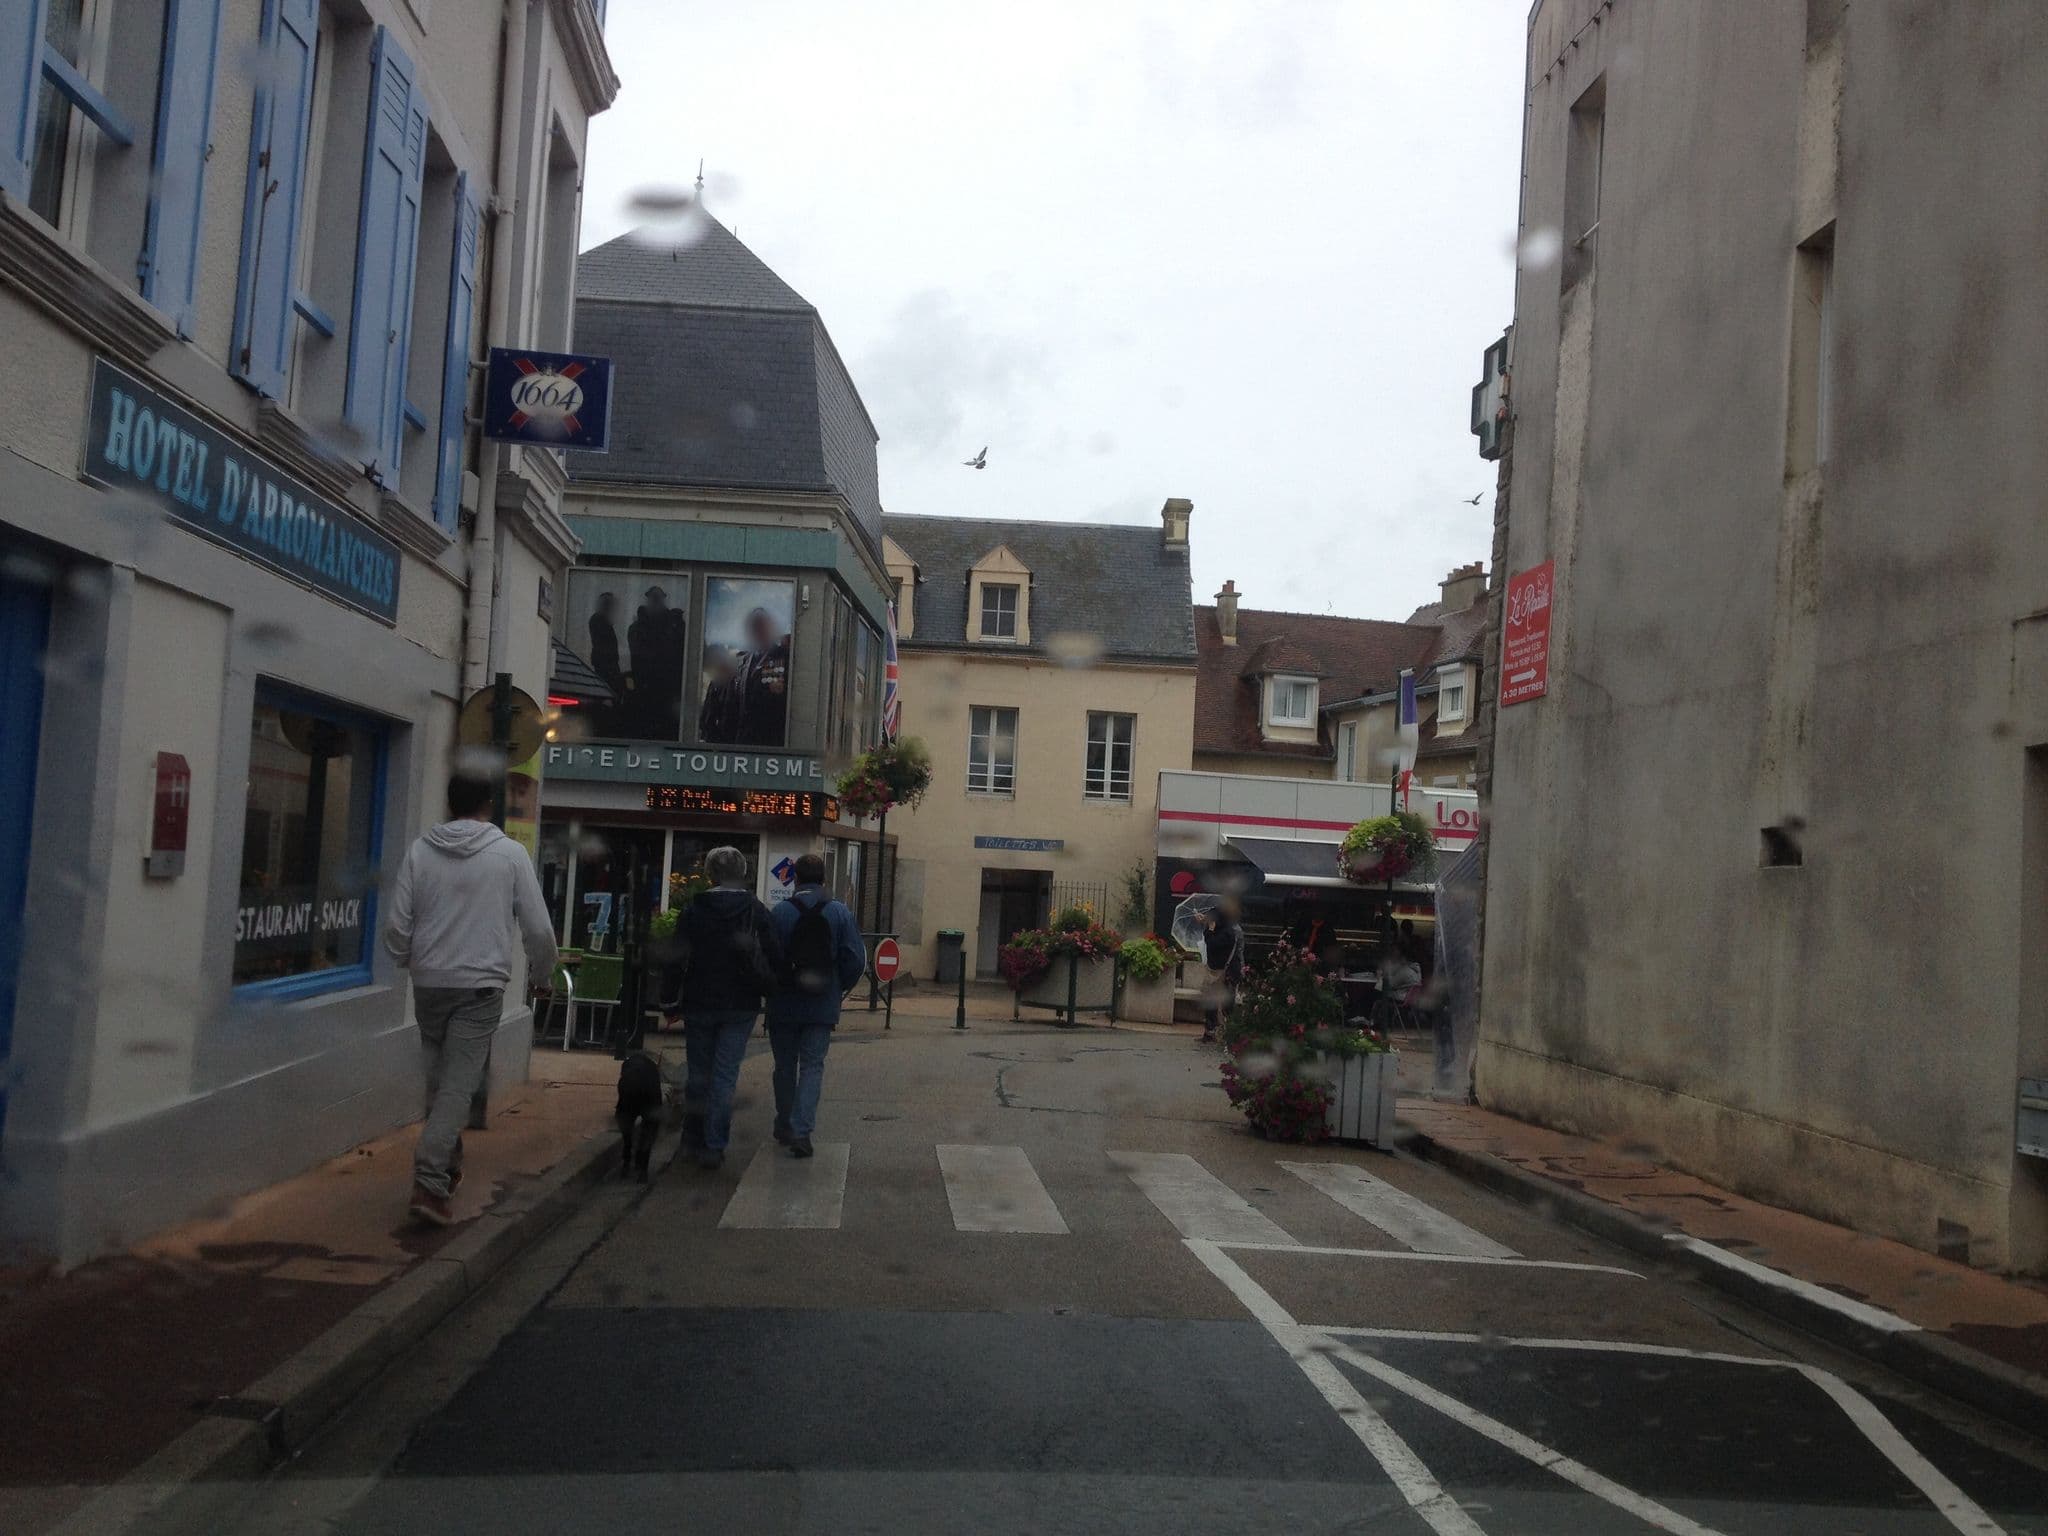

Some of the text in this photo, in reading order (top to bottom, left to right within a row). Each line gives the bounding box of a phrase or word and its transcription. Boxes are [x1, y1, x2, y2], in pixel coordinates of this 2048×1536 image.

[515, 378, 578, 411] 1664
[218, 459, 394, 607] D'ARROMANCHES
[672, 752, 823, 778] TOURISME
[322, 899, 360, 930] SNACK
